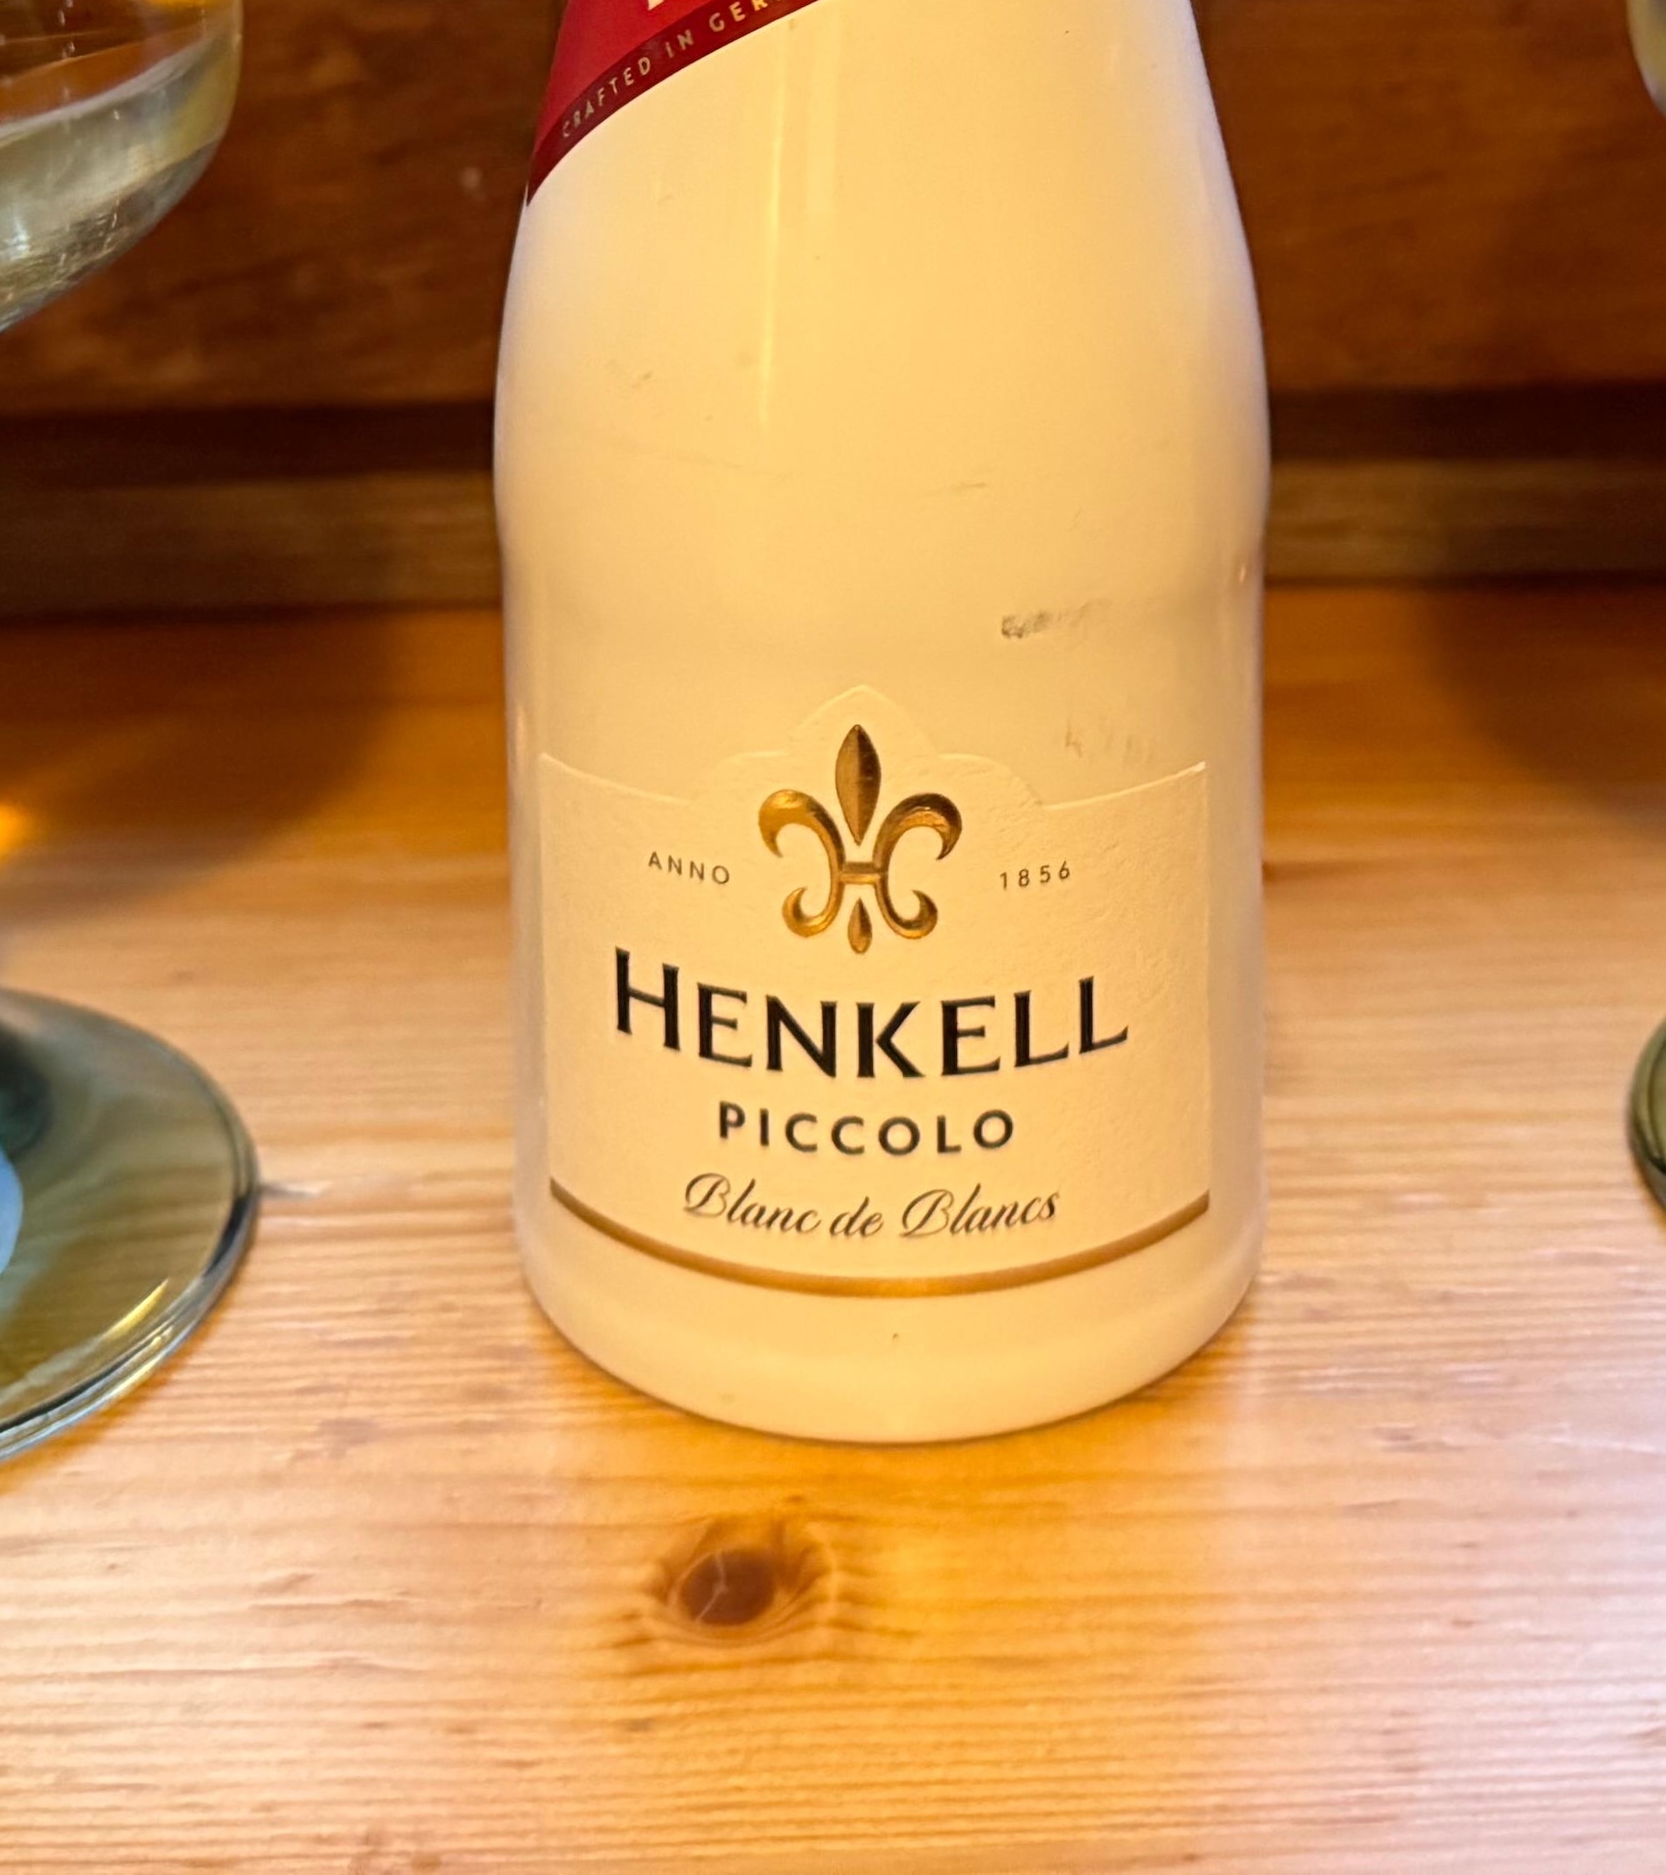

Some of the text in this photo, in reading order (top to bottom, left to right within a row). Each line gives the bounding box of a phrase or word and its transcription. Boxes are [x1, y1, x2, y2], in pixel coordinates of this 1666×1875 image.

[562, 57, 652, 139] CRAFTED
[665, 29, 694, 59] IN
[647, 851, 1073, 890] ANNO 1856
[614, 946, 1129, 1079] HENKELL
[718, 1100, 1015, 1156] PICCOLO
[682, 1172, 1060, 1240] Blanc de Blancs
